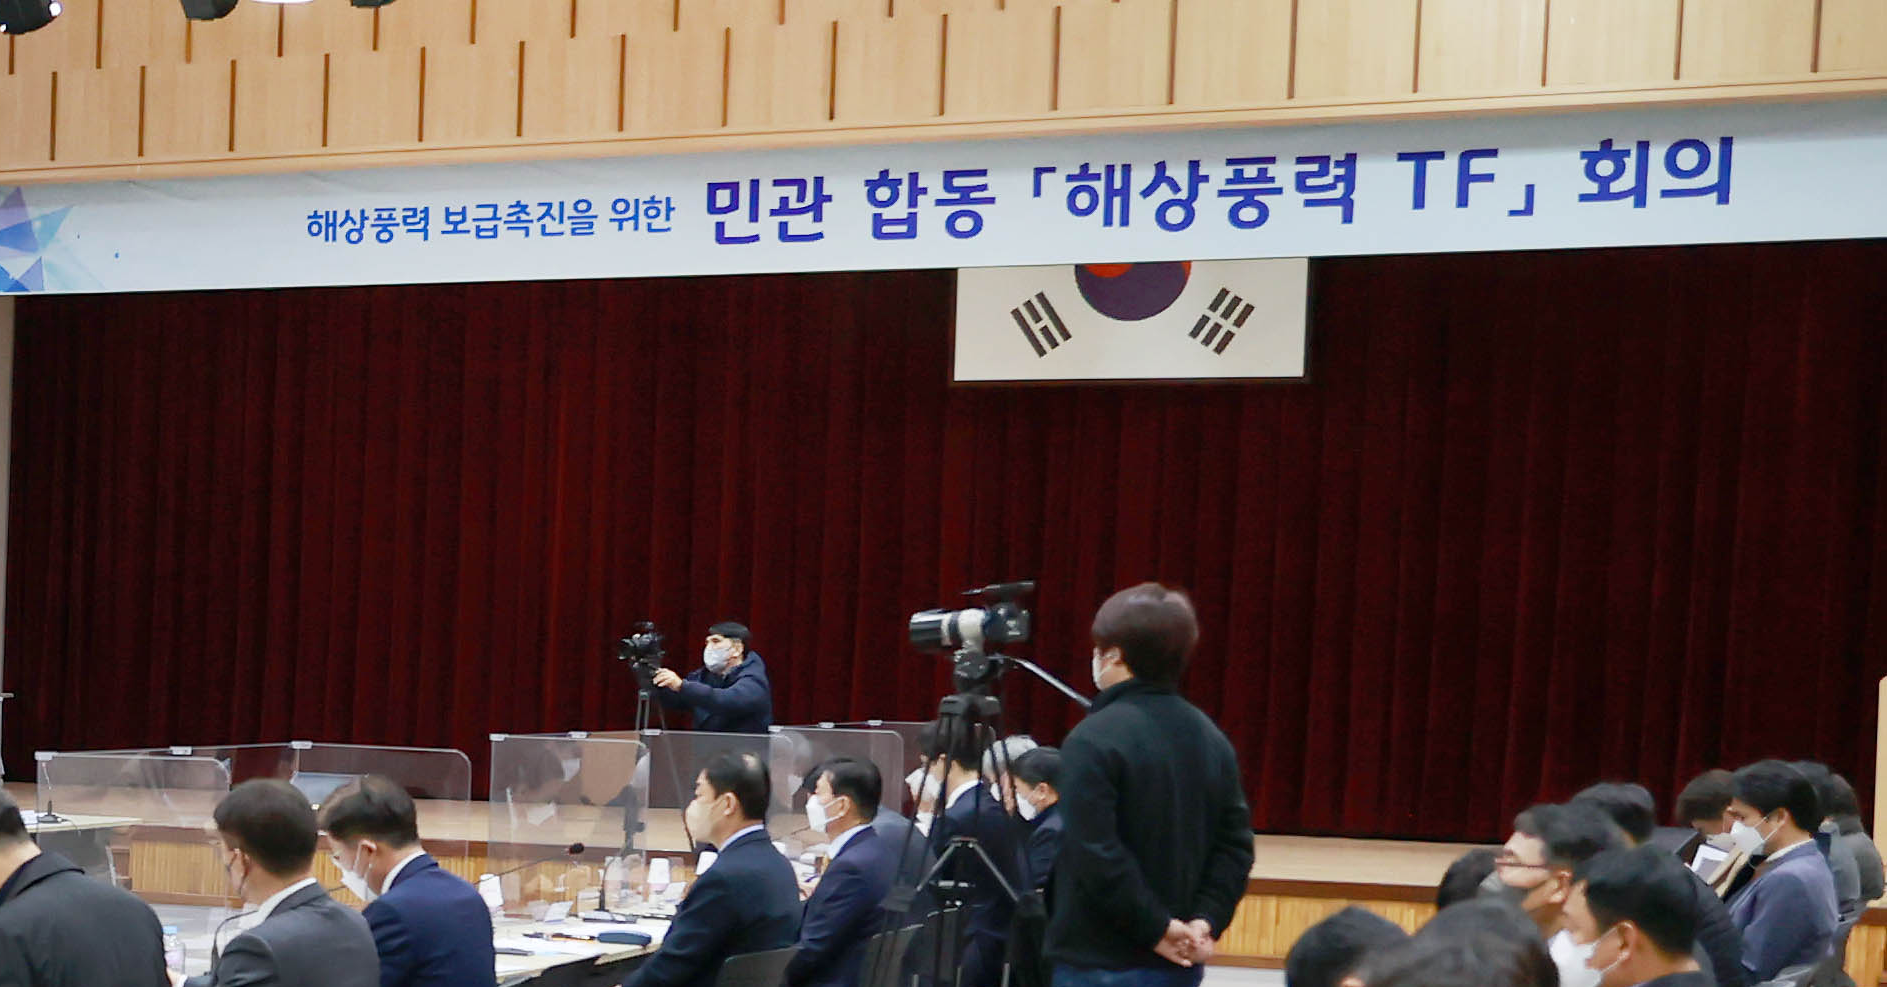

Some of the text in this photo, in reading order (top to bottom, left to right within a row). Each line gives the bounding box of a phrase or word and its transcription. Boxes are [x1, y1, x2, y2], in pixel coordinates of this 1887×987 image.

[305, 206, 431, 245] 해상풍력
[440, 198, 600, 240] 보급촉진을
[608, 194, 677, 233] 위한
[705, 175, 835, 245] 민관
[864, 167, 998, 241] 합동
[1577, 135, 1735, 209] 회의
